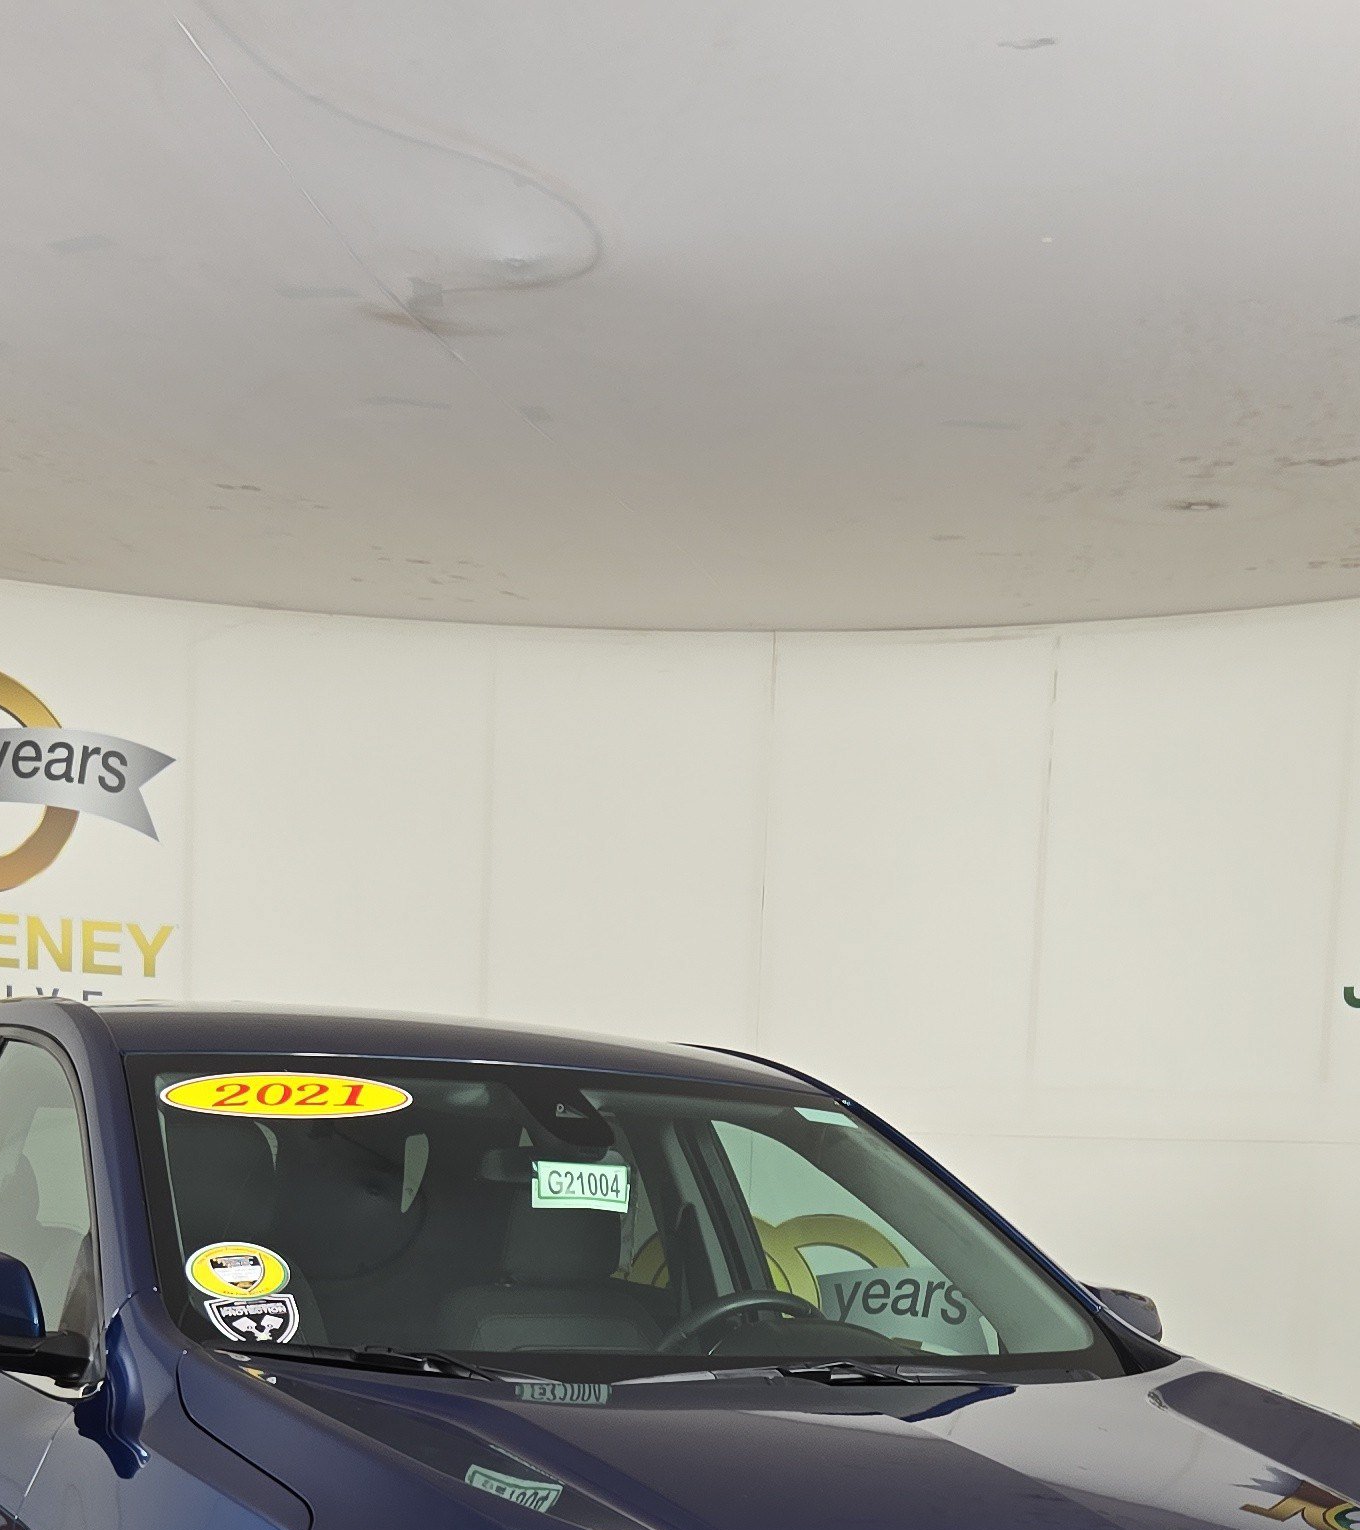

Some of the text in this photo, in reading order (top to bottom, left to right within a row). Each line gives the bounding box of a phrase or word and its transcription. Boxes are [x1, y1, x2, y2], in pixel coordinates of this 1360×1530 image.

[212, 1083, 365, 1108] 2021
[547, 1168, 621, 1199] G21004
[834, 1275, 969, 1327] years
